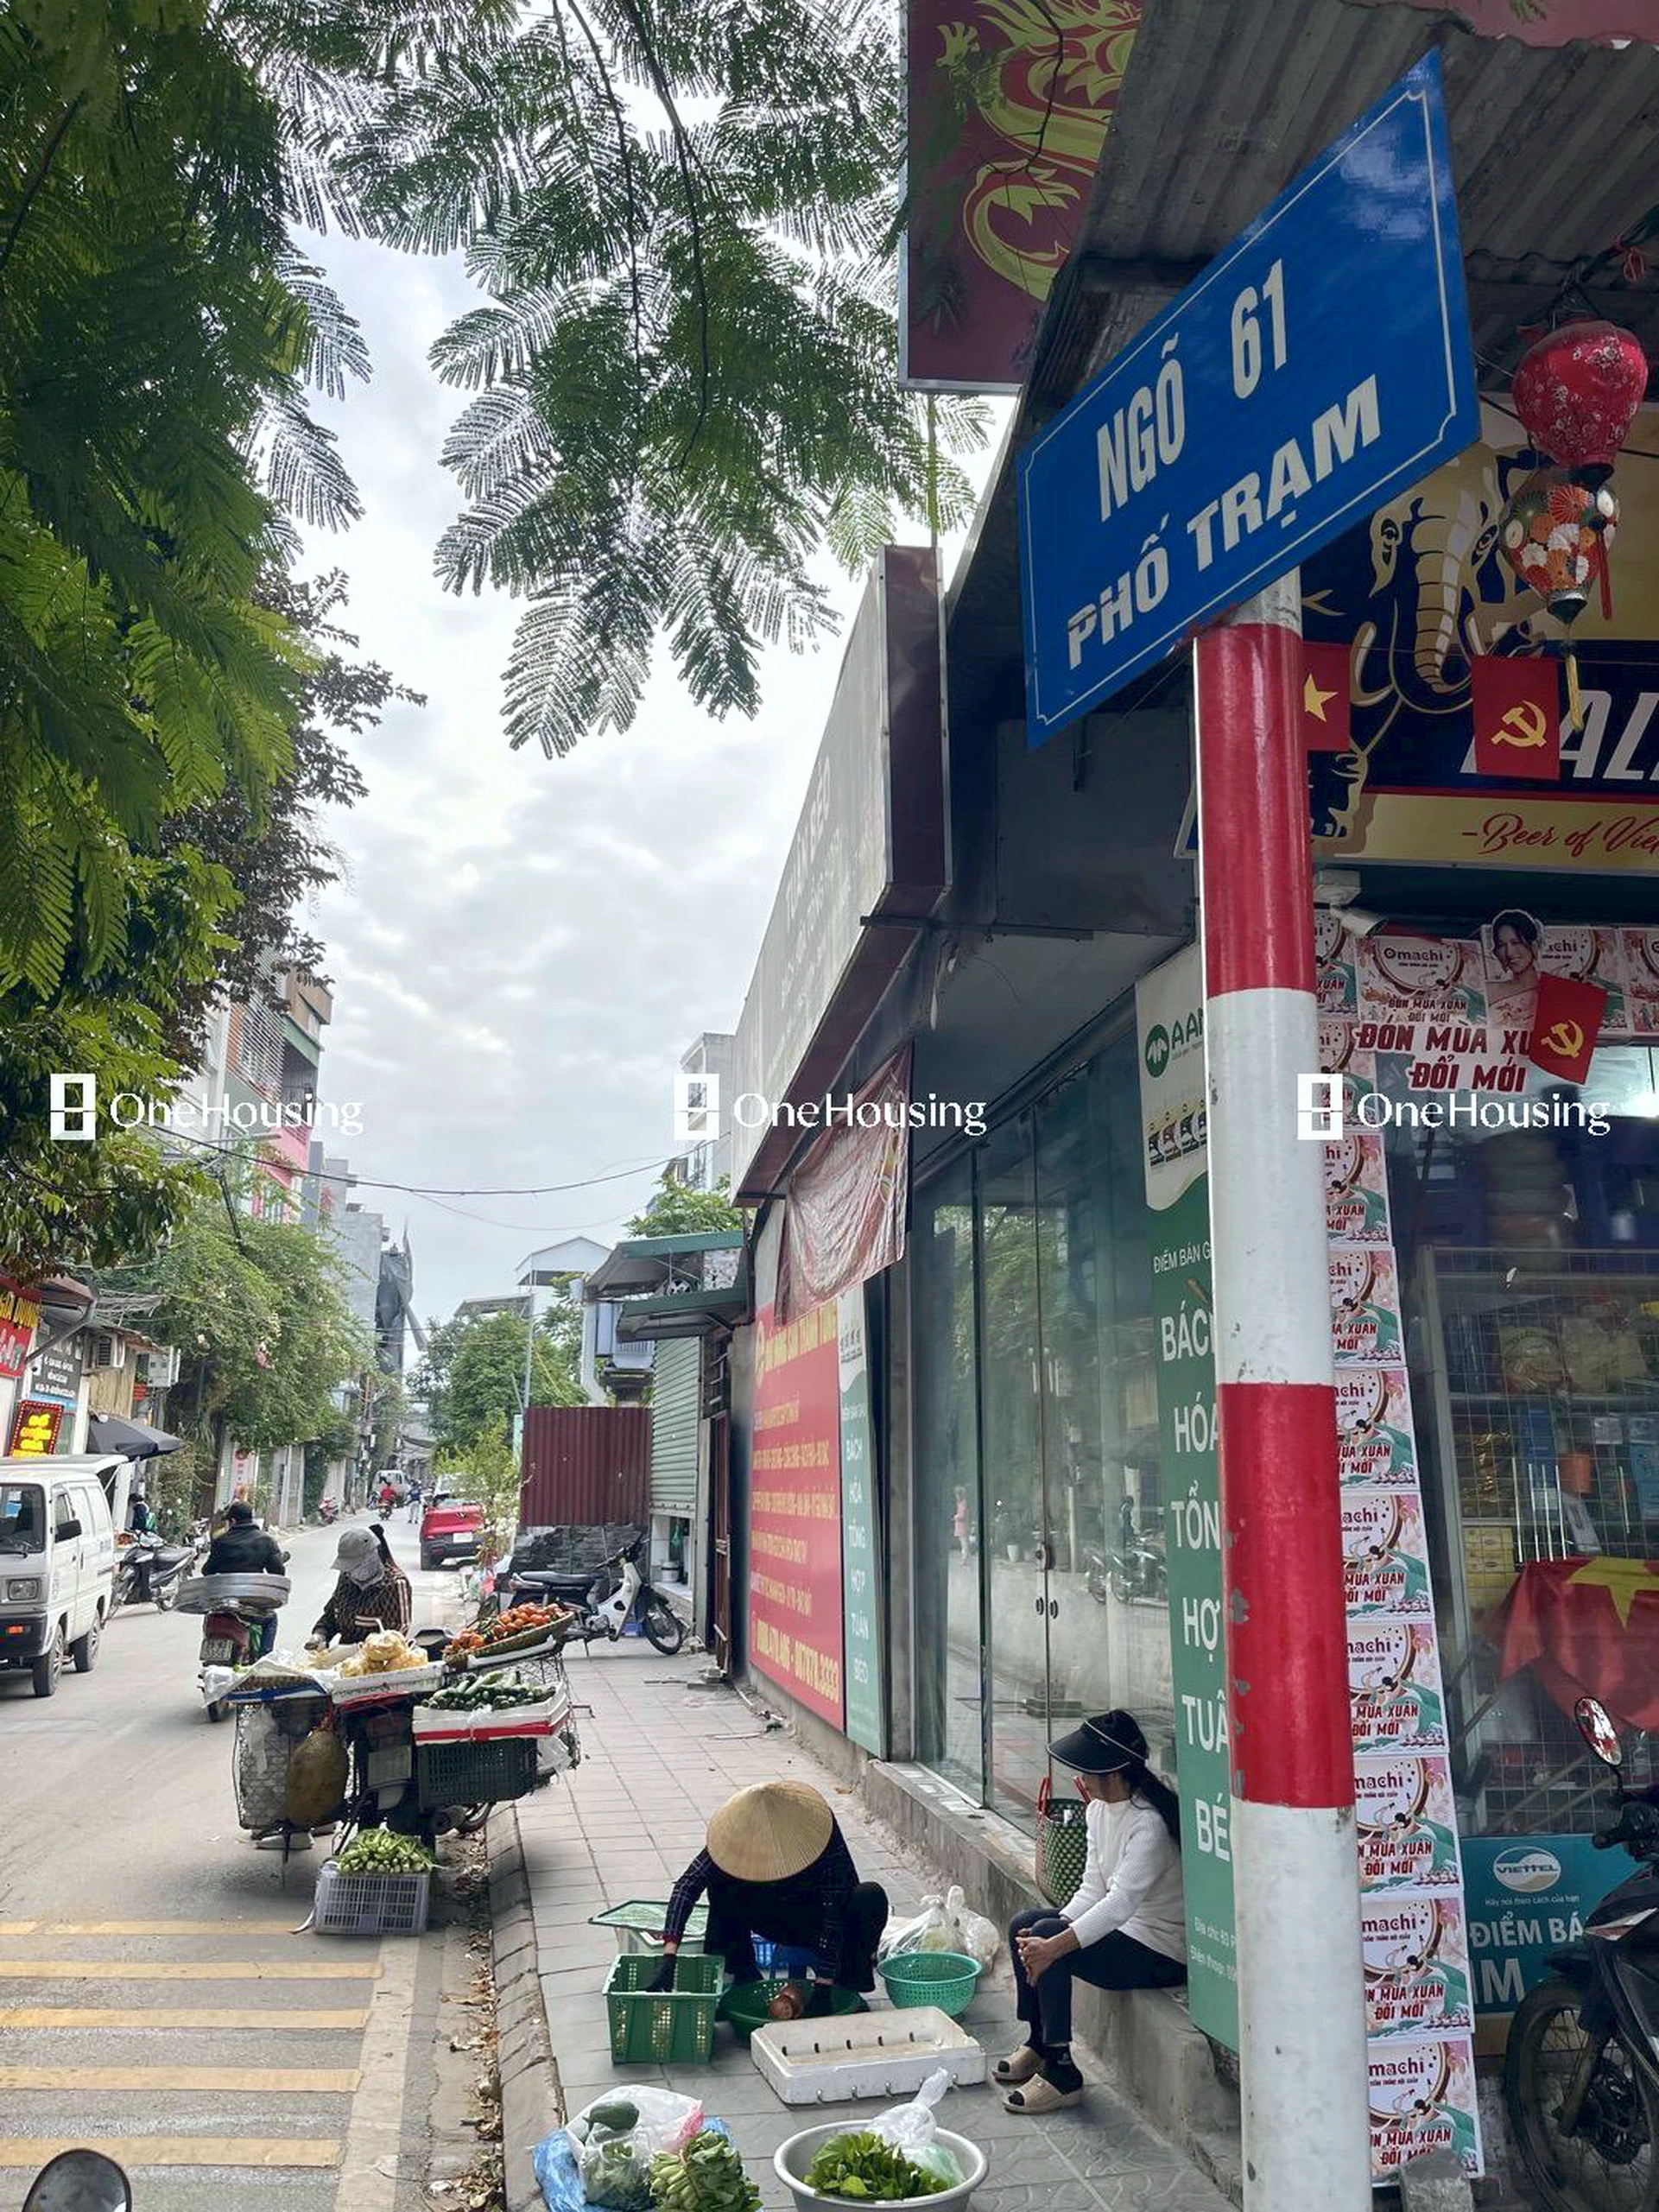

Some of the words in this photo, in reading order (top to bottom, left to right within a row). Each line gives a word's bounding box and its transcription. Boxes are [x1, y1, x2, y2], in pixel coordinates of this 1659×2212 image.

[1097, 333, 1186, 522] NGÕ
[1232, 258, 1288, 399] 61
[1067, 513, 1169, 670] PHỐ
[1187, 374, 1382, 572] TRẠM
[1564, 821, 1602, 858] of
[1384, 947, 1444, 961] Omachi
[1355, 1014, 1415, 1051] ĐÓN
[1410, 1055, 1460, 1090] ĐỔI
[1472, 1056, 1527, 1093] MỚI
[1180, 1242, 1200, 1266] BÁN
[1329, 1262, 1352, 1276] chi
[1171, 1480, 1220, 1550] TỔN
[1342, 1507, 1378, 1523] achi
[1182, 1597, 1222, 1664] HỢ
[1354, 1772, 1403, 1789] machi
[1195, 1793, 1230, 1862] BÉ
[1402, 1838, 1432, 1855] XUÂN
[1364, 1857, 1385, 1875] ĐỔI
[1390, 1857, 1413, 1874] MỚI
[1362, 1913, 1416, 1933] machi
[1470, 1911, 1543, 1949] ĐIỂM
[1548, 1911, 1585, 1943] BÁ
[1412, 1981, 1444, 1999] XUÂN
[1469, 1957, 1526, 2005] IM
[1375, 2001, 1396, 2020] ĐỔI
[1401, 2000, 1424, 2018] MỚI
[1369, 2057, 1424, 2076] machi
[1419, 2126, 1451, 2144] XUÂN
